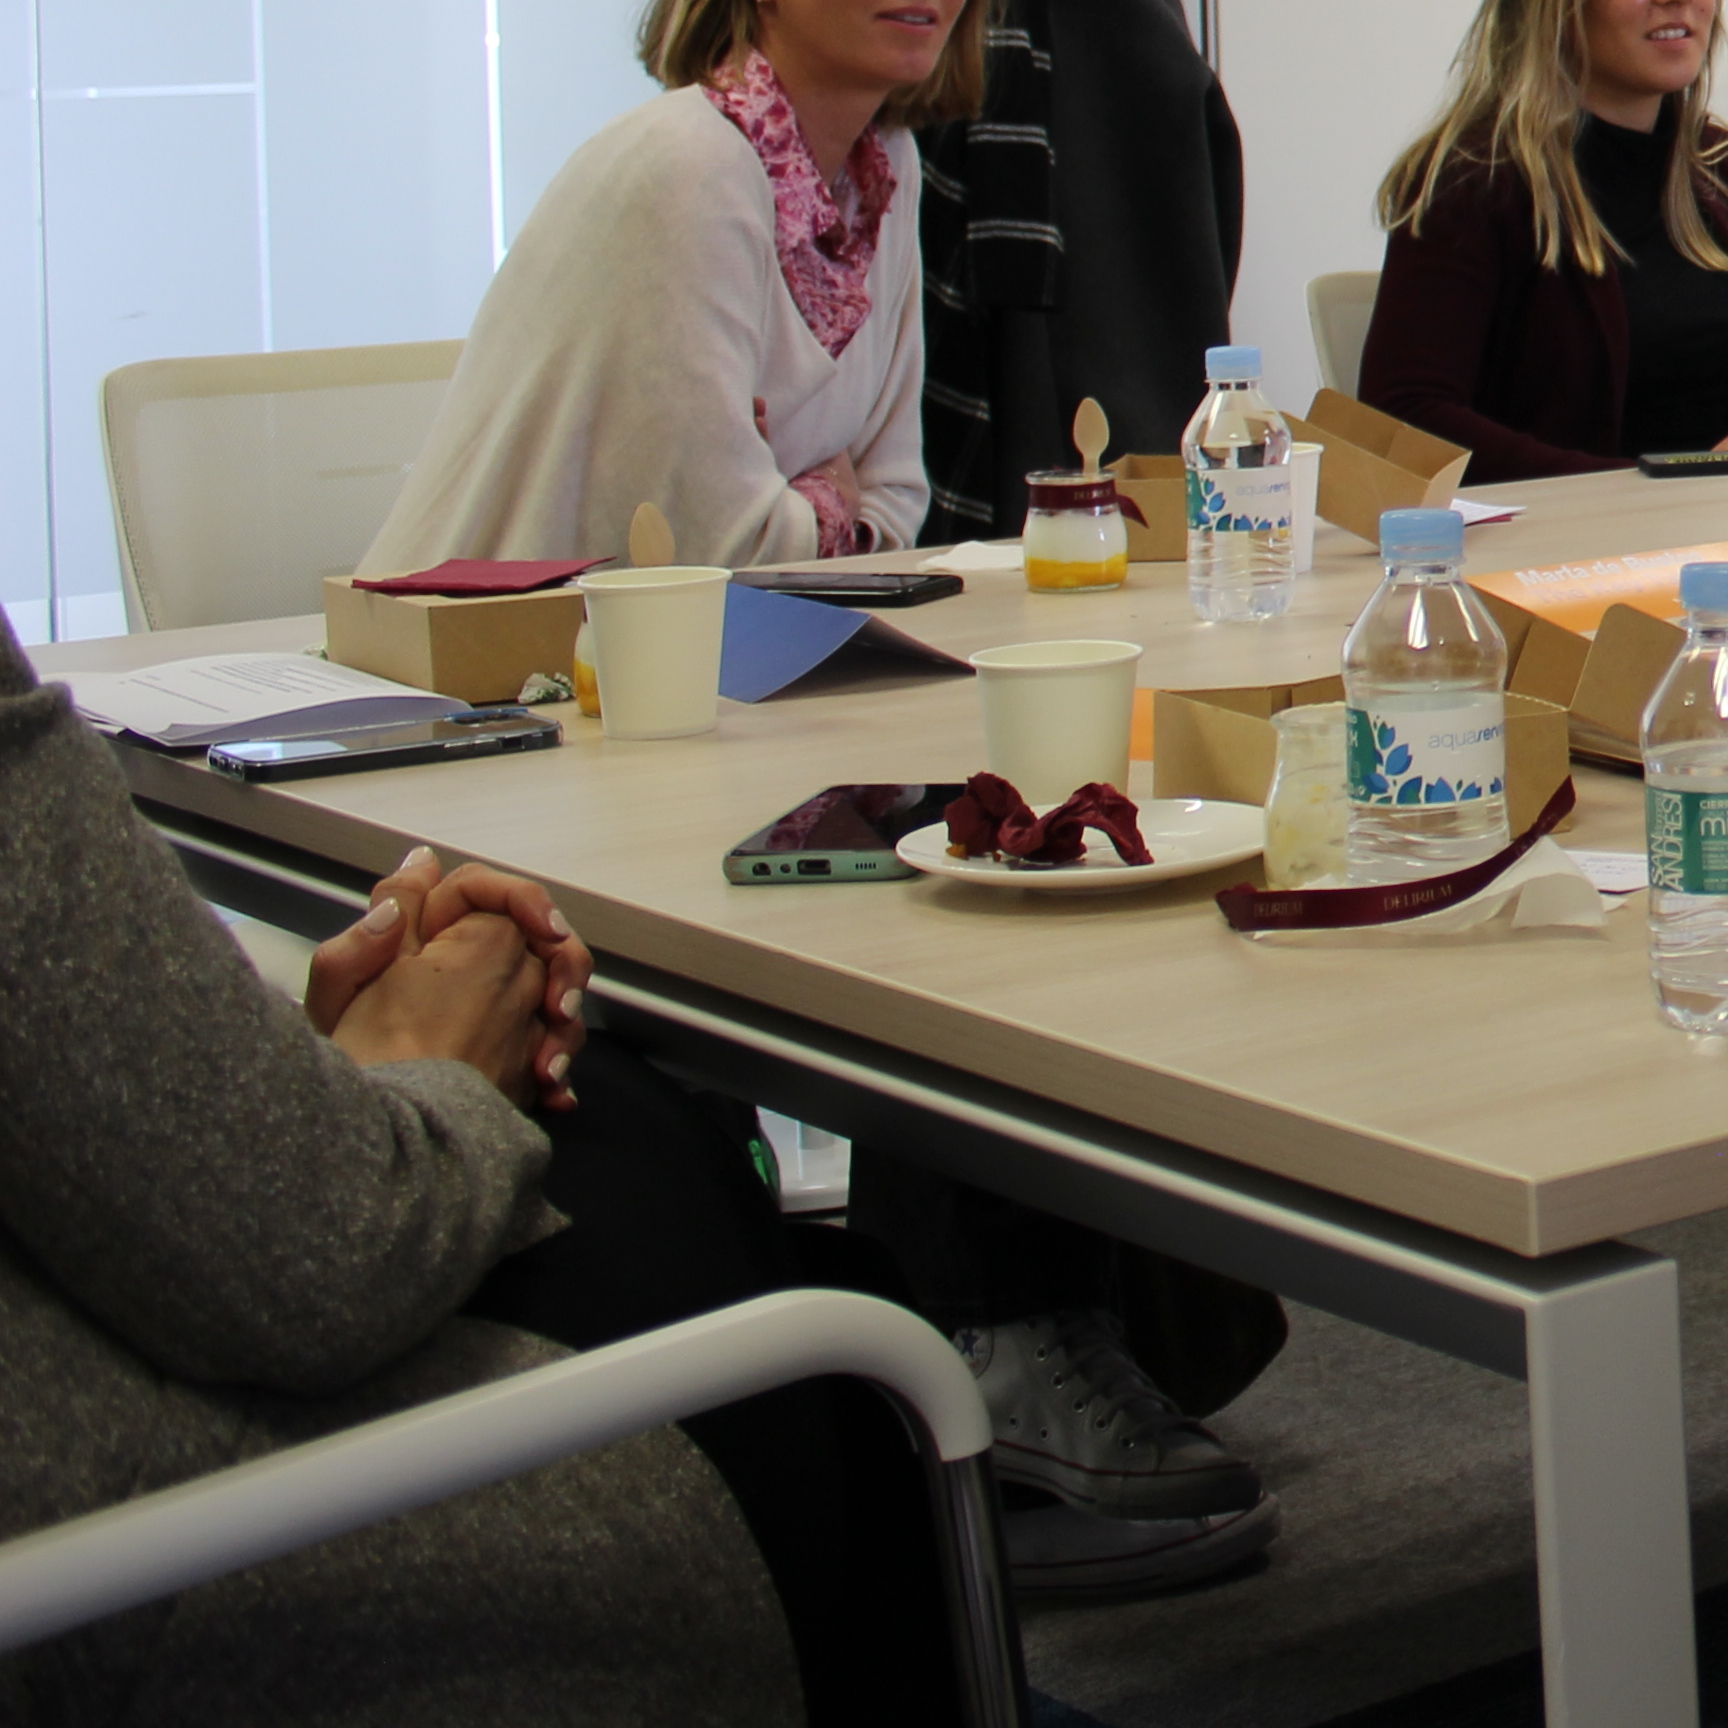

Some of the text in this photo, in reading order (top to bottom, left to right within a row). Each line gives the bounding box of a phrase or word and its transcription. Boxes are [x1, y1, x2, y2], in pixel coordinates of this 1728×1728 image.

[1514, 565, 1592, 587] Marta
[1591, 561, 1623, 577] de
[1650, 833, 1664, 887] SAN
[1383, 883, 1453, 912] DELIRIUM
